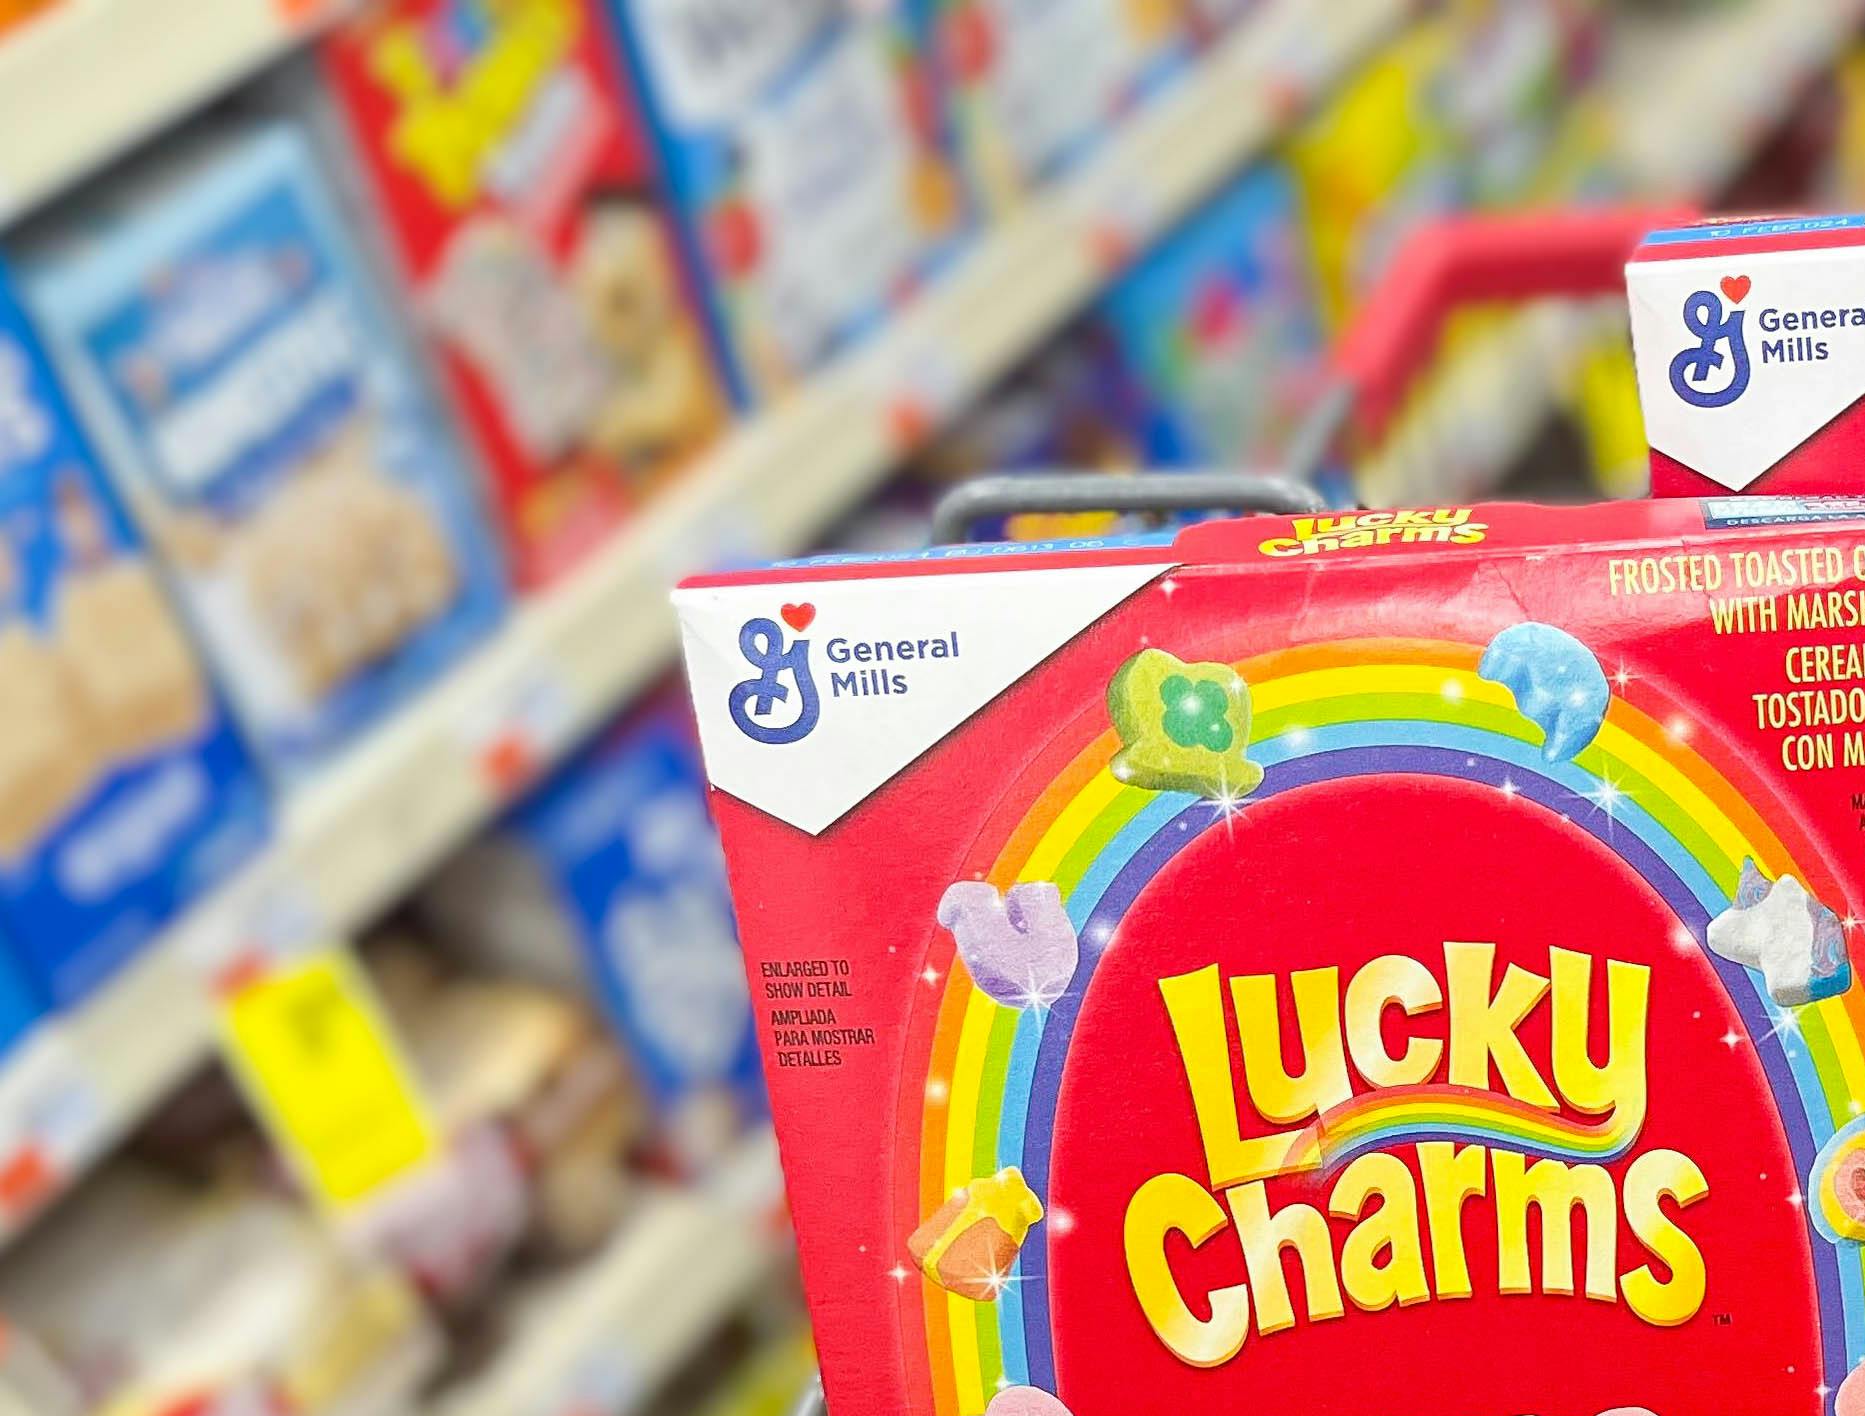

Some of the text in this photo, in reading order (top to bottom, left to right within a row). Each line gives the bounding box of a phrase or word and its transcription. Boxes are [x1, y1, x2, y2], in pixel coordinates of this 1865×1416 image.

[1761, 336, 1830, 365] Mills
[1257, 523, 1489, 558] Charms
[1291, 508, 1474, 541] Lucky
[1609, 554, 1722, 597] FROSTED
[1733, 546, 1844, 588] TOASTED
[1710, 596, 1777, 635] WITH
[825, 631, 961, 663] General
[831, 667, 910, 699] Mills
[1781, 730, 1835, 772] CON
[761, 959, 850, 978] ENLARGED TO
[765, 981, 852, 999] SHOW DETAIL
[771, 1008, 837, 1026] AMPLIADA
[774, 1028, 875, 1047] PARA MOSTRAR
[777, 1050, 842, 1067] DETALLES
[1158, 942, 1651, 1190] Lucky
[1123, 1142, 1710, 1368] Charms
